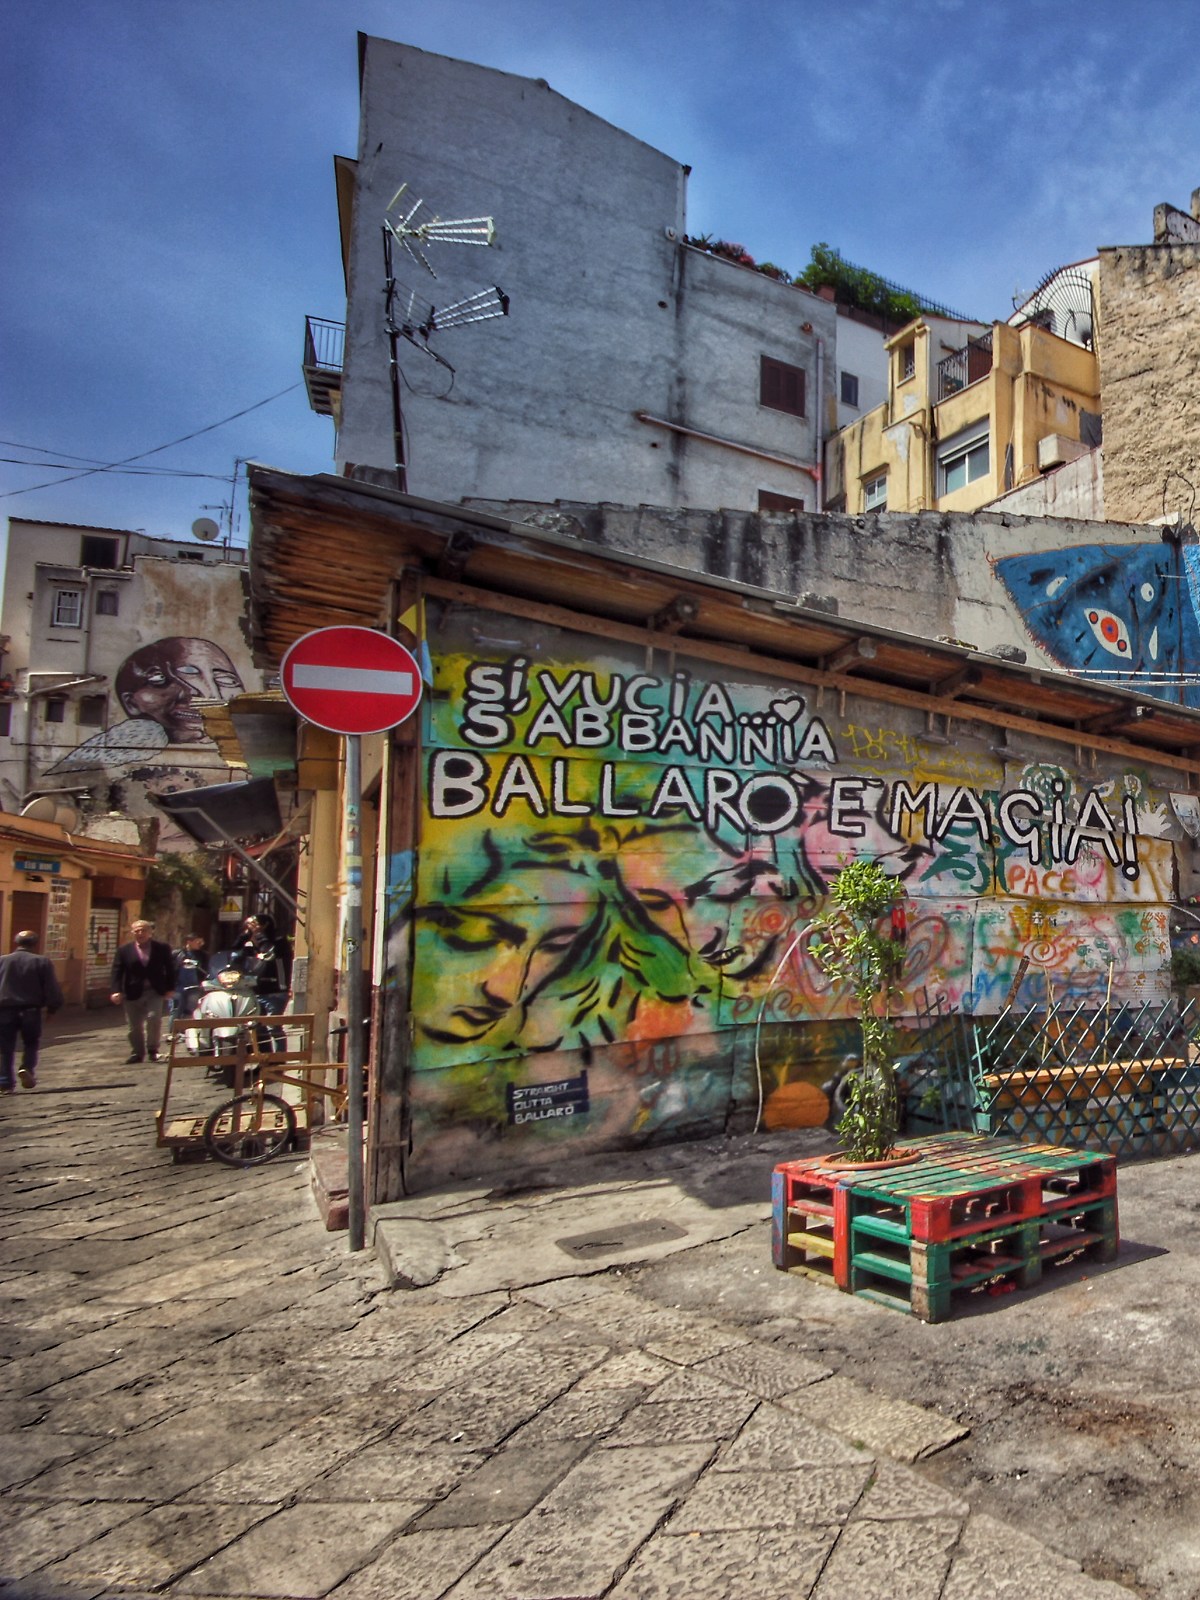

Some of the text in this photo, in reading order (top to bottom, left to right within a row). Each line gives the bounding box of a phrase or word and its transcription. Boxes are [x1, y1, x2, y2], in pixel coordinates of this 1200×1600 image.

[1006, 864, 1077, 895] PACE
[512, 1082, 569, 1099] STRAIGHT
[513, 1097, 552, 1111] OUTTA
